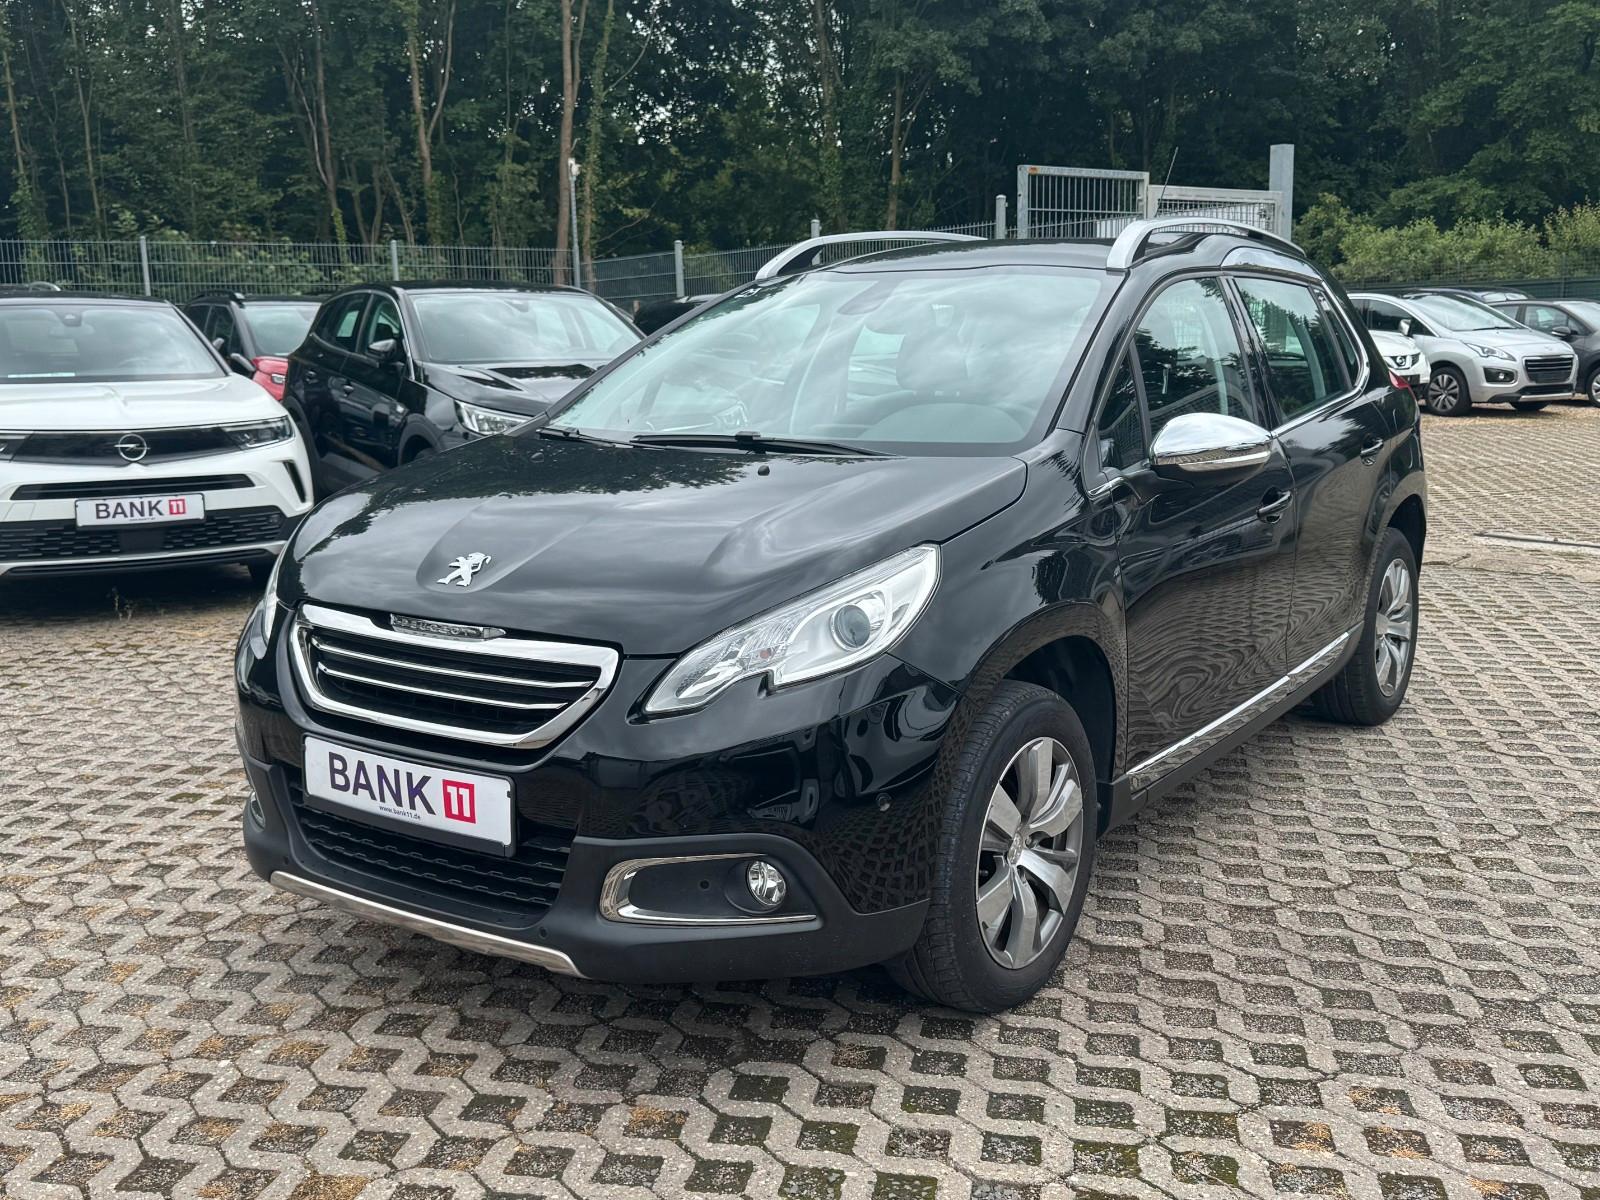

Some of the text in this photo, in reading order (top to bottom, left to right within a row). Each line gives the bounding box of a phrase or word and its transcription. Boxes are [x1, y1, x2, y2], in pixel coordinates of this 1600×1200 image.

[95, 500, 185, 519] BANK 11
[328, 751, 473, 819] BANK 11
[379, 805, 421, 820] www.bank11.de
